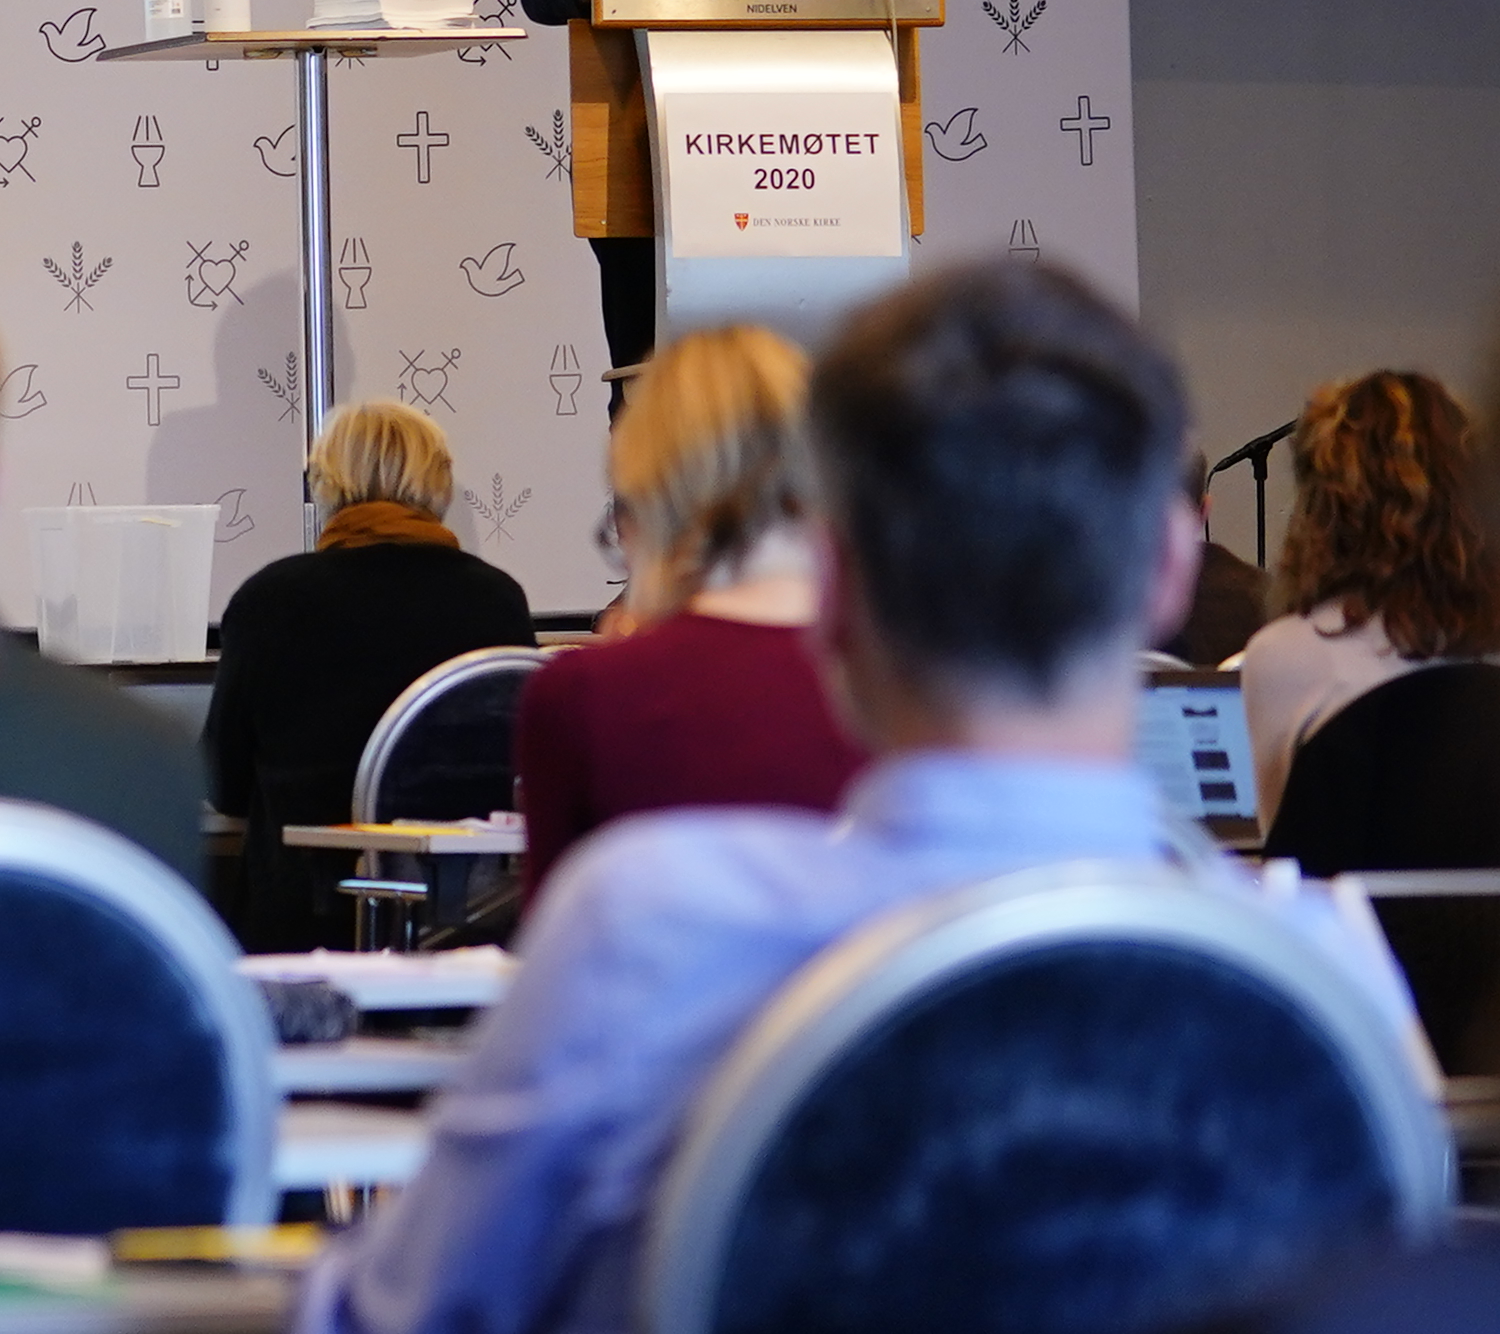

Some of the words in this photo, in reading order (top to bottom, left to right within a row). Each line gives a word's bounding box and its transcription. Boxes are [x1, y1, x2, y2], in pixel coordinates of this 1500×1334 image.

[746, 3, 798, 14] NIDELVEN
[685, 132, 881, 156] KIRKEMØTET
[753, 167, 817, 191] 2020
[752, 217, 771, 228] DEN
[774, 217, 811, 228] NORSKE
[813, 217, 842, 228] KIRKE
